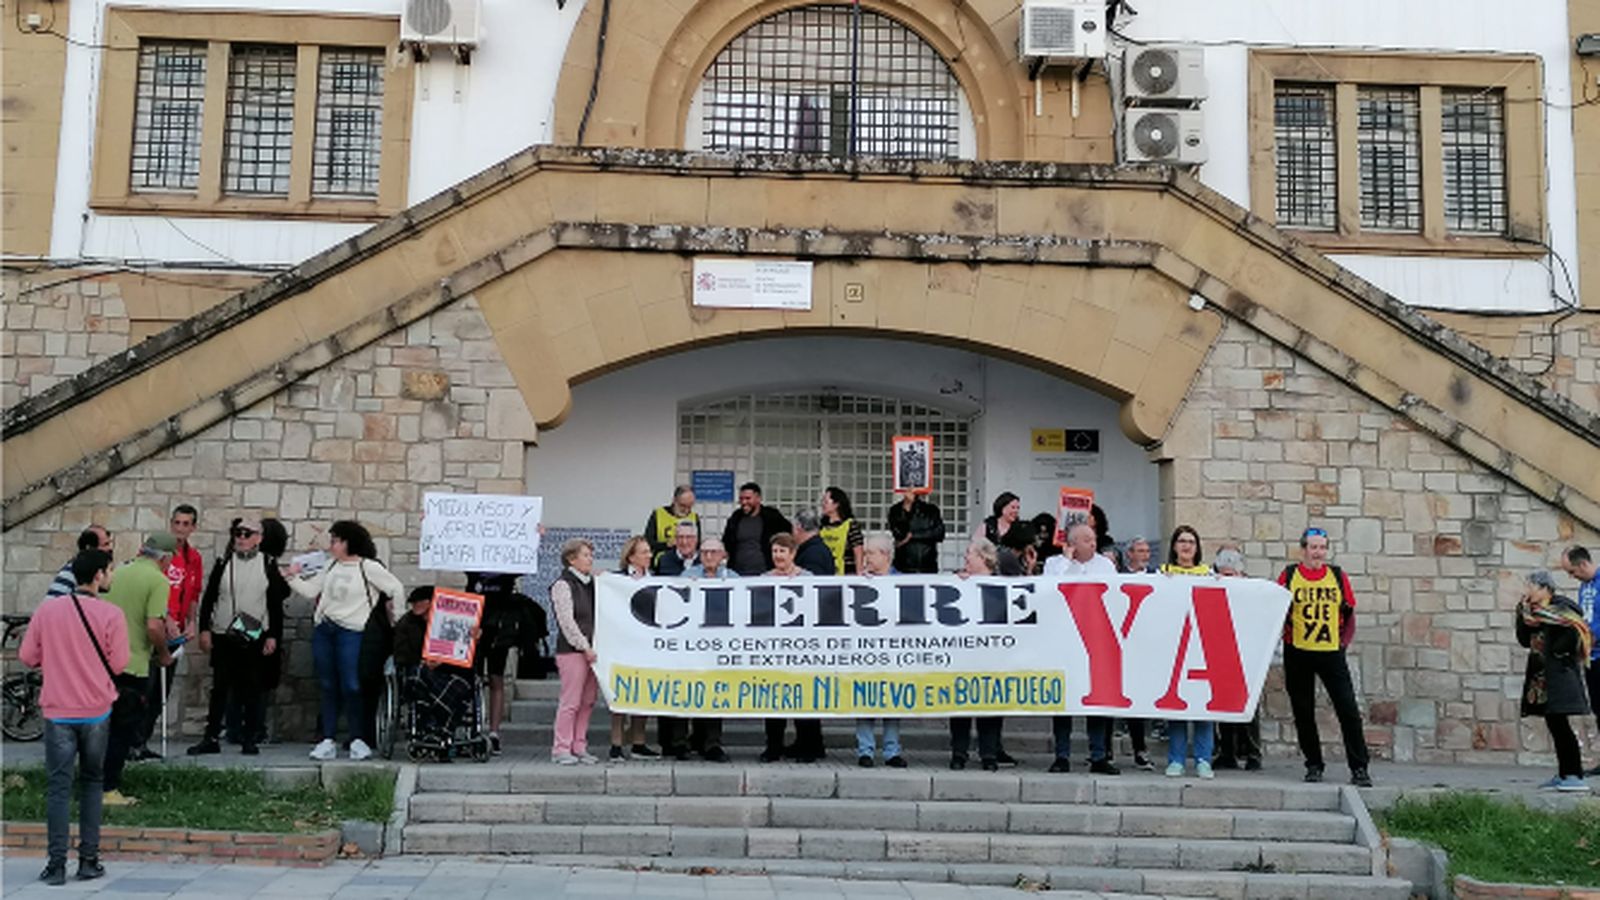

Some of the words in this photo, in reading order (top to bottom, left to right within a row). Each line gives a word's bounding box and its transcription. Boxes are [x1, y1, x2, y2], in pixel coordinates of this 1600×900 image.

[630, 584, 1037, 628] CIERRE
[1302, 604, 1331, 621] CIE
[653, 638, 678, 650] DE
[685, 638, 723, 650] LOS
[728, 638, 821, 650] CENTROS
[826, 638, 851, 650] DE
[857, 635, 1016, 649] INTERNAMIENTO
[1303, 621, 1333, 643] YA
[1057, 583, 1248, 712] YA
[717, 654, 742, 666] DE
[749, 652, 890, 666] EXTRANJEROS
[896, 652, 951, 667] (CIEs)
[853, 680, 916, 710] NUEVO
[925, 686, 951, 706] EN
[954, 675, 1062, 706] BOTAFUEGO
